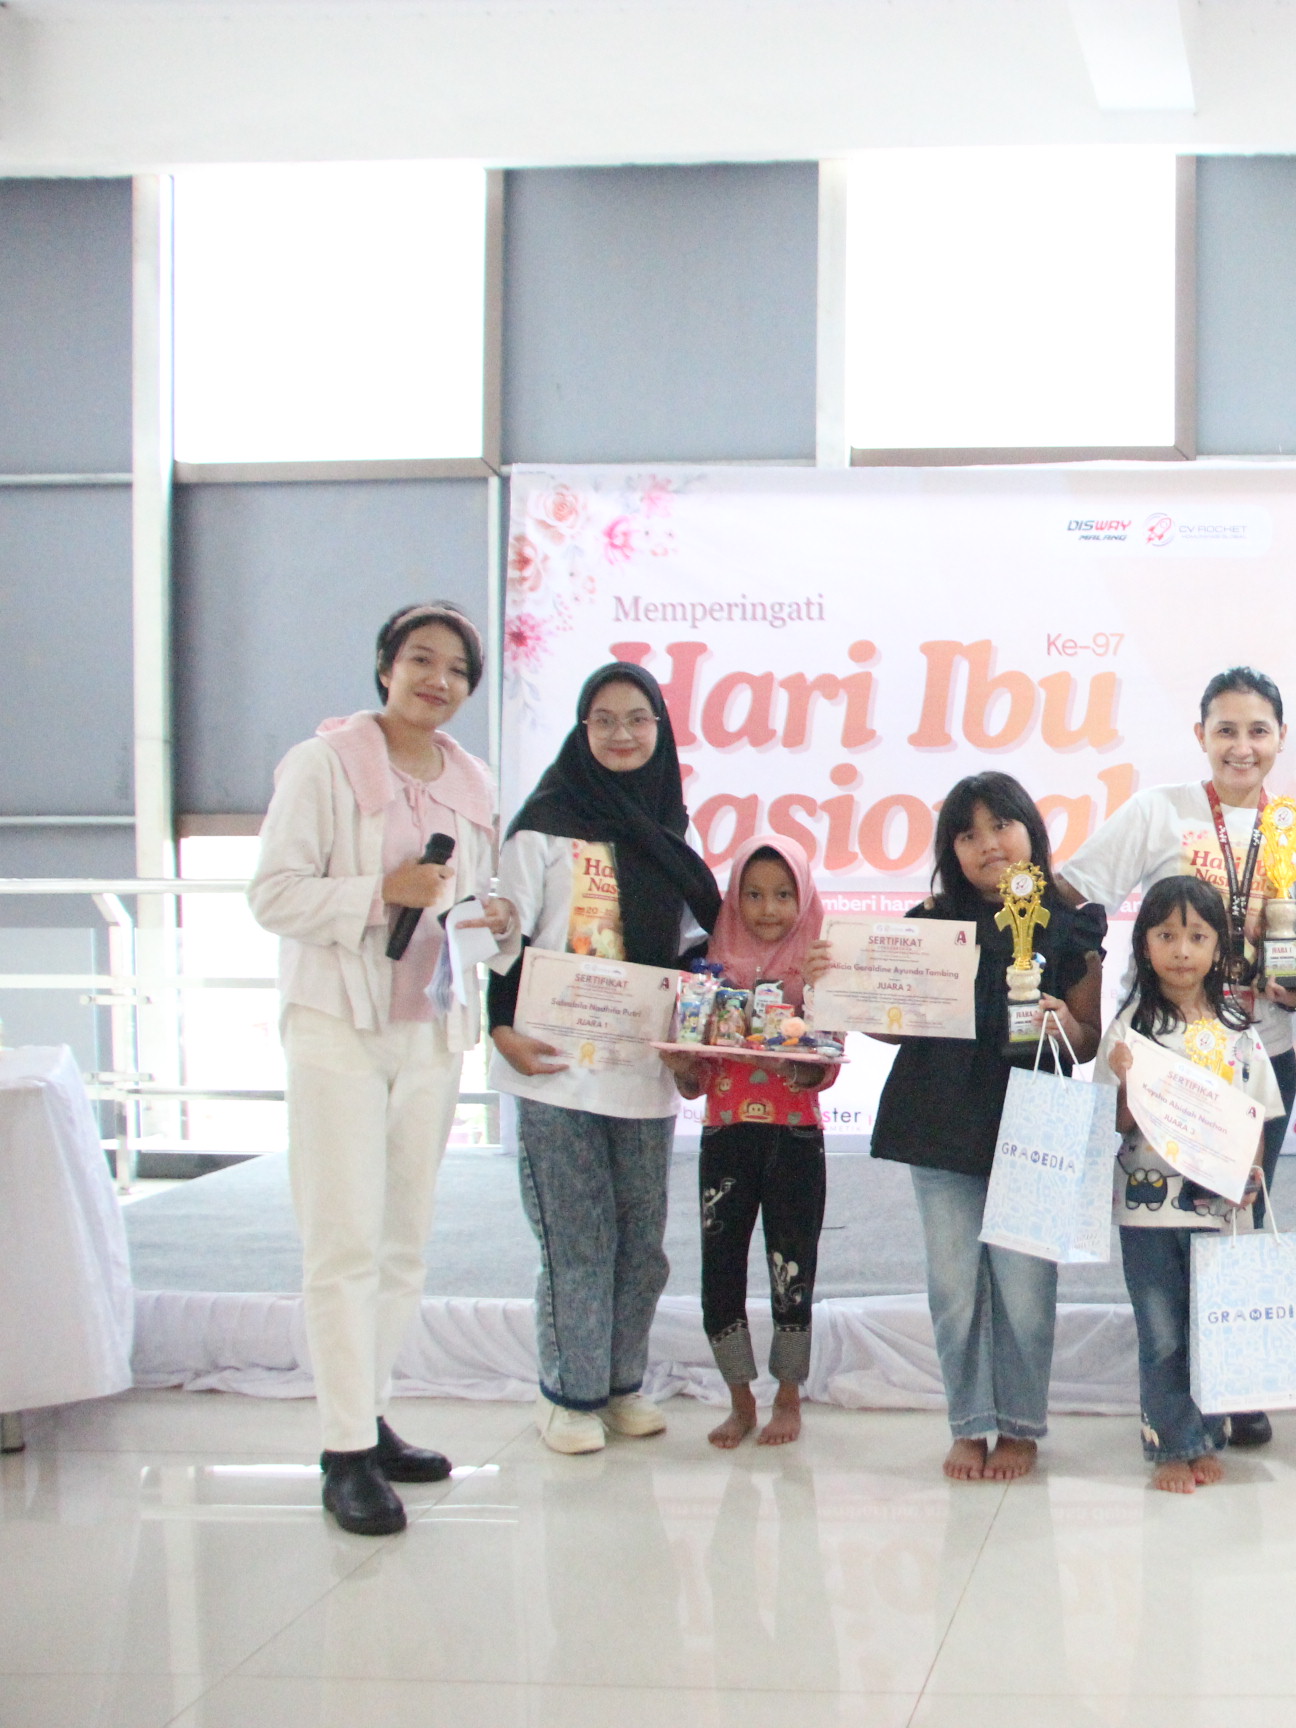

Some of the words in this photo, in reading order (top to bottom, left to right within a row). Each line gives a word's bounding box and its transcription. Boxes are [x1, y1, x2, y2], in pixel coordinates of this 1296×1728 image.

[1067, 519, 1132, 531] DISWAY
[612, 593, 826, 629] Memperingati
[1047, 632, 1125, 656] Ke-97
[609, 640, 878, 749] Hari
[908, 640, 1120, 749] Ibu
[582, 857, 616, 879] Ha
[1190, 849, 1242, 874] Hai
[588, 877, 618, 894] Nas
[822, 894, 877, 911] mberi
[868, 935, 923, 947] SERTIFIKAT
[955, 931, 967, 945] A
[574, 973, 630, 988] SERTIFIKAT
[876, 982, 904, 991] JUARA
[576, 1018, 602, 1028] JUARA
[1167, 1071, 1221, 1101] SERTIFIKAT
[822, 1107, 861, 1123] ster
[1164, 1113, 1188, 1132] JUARA
[1001, 1142, 1076, 1174] GRAMEDIA
